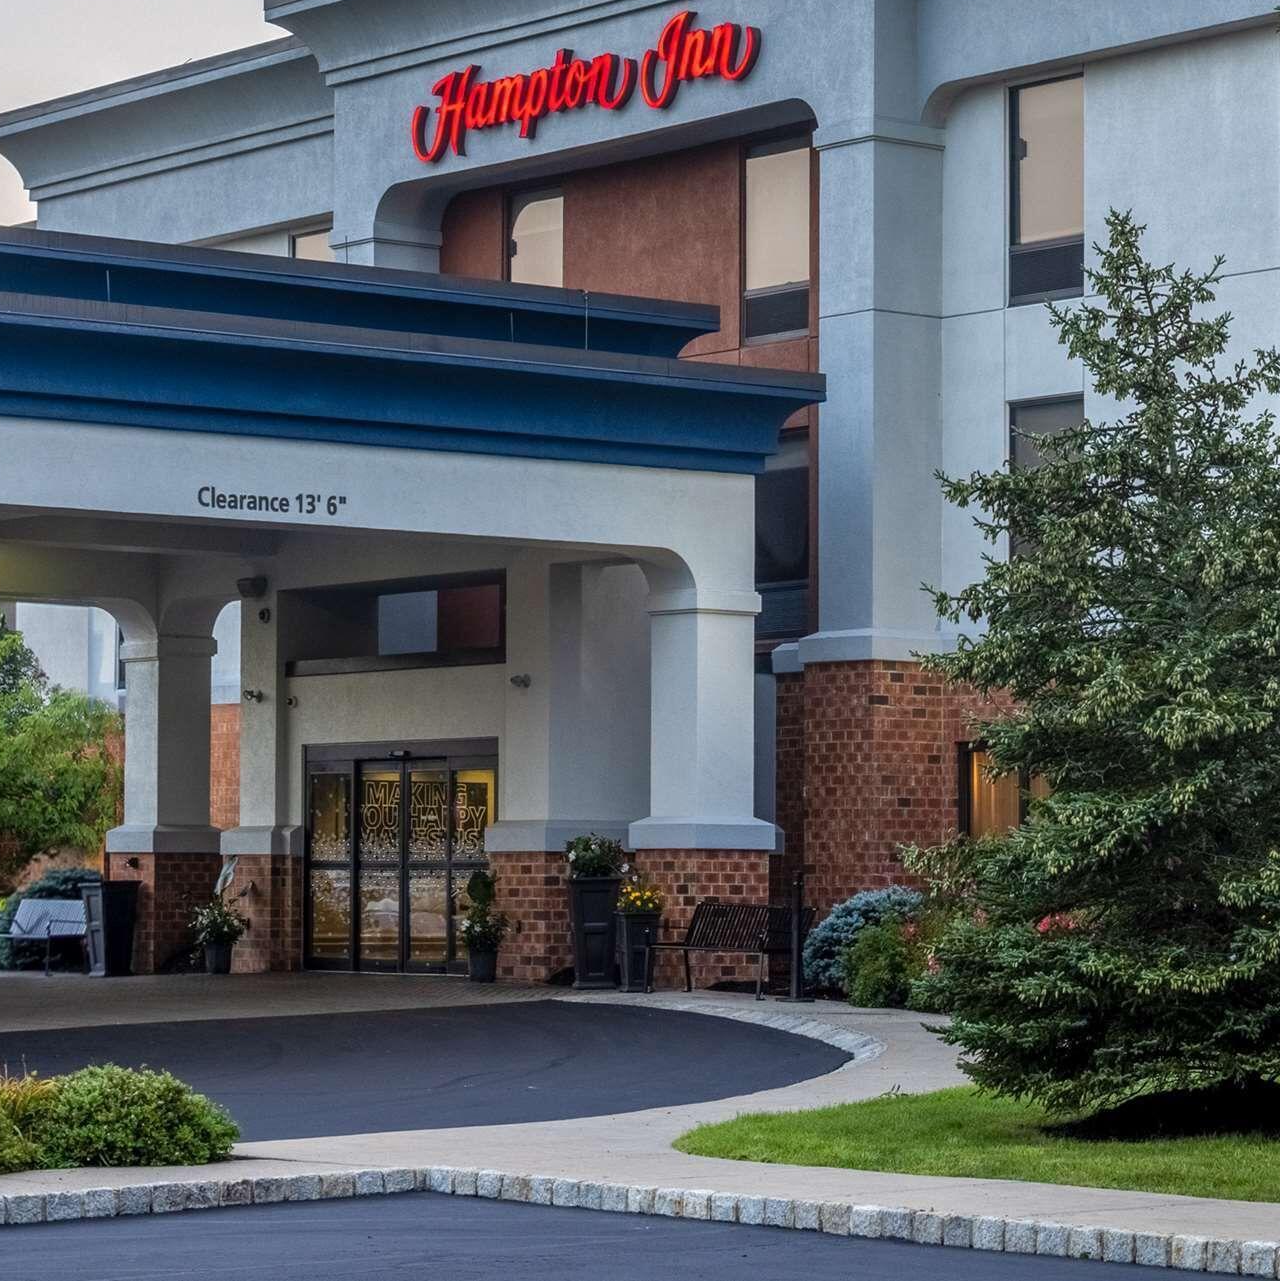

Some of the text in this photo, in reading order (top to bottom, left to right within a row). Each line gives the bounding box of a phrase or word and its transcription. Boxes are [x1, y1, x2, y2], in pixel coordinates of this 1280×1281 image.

[411, 11, 762, 162] Hampton Inn
[197, 486, 290, 513] Clearance
[295, 493, 321, 514] 13'
[361, 804, 399, 830] OU
